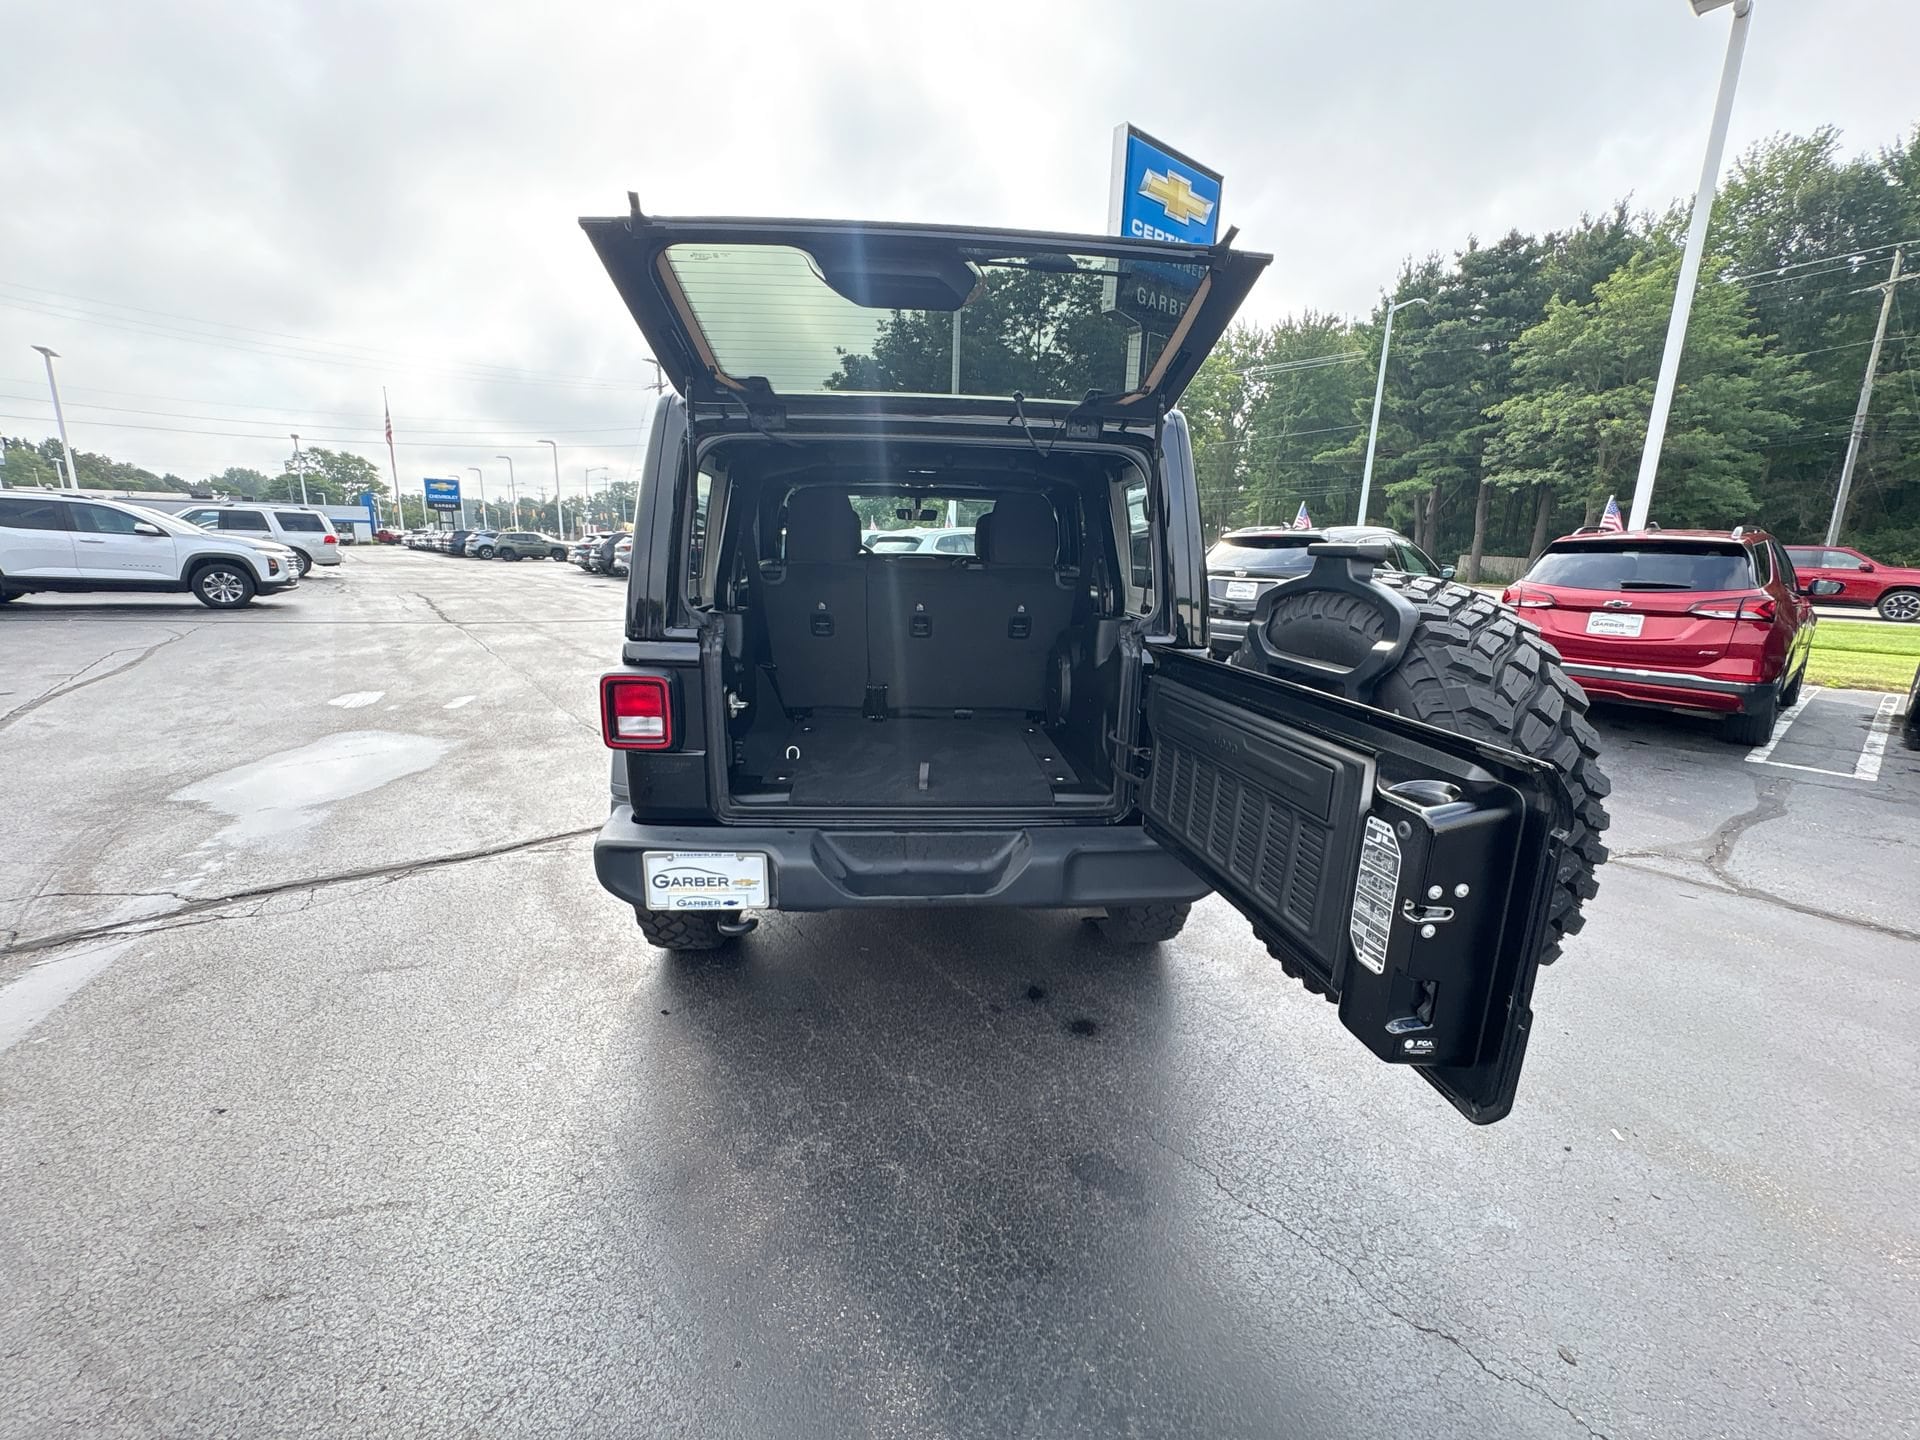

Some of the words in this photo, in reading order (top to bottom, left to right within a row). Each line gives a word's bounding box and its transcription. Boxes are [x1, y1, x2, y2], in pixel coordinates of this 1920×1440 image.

[1137, 286, 1188, 318] GARBE
[1366, 832, 1396, 849] JL
[652, 874, 730, 889] GARBER
[676, 899, 721, 907] GARBER
